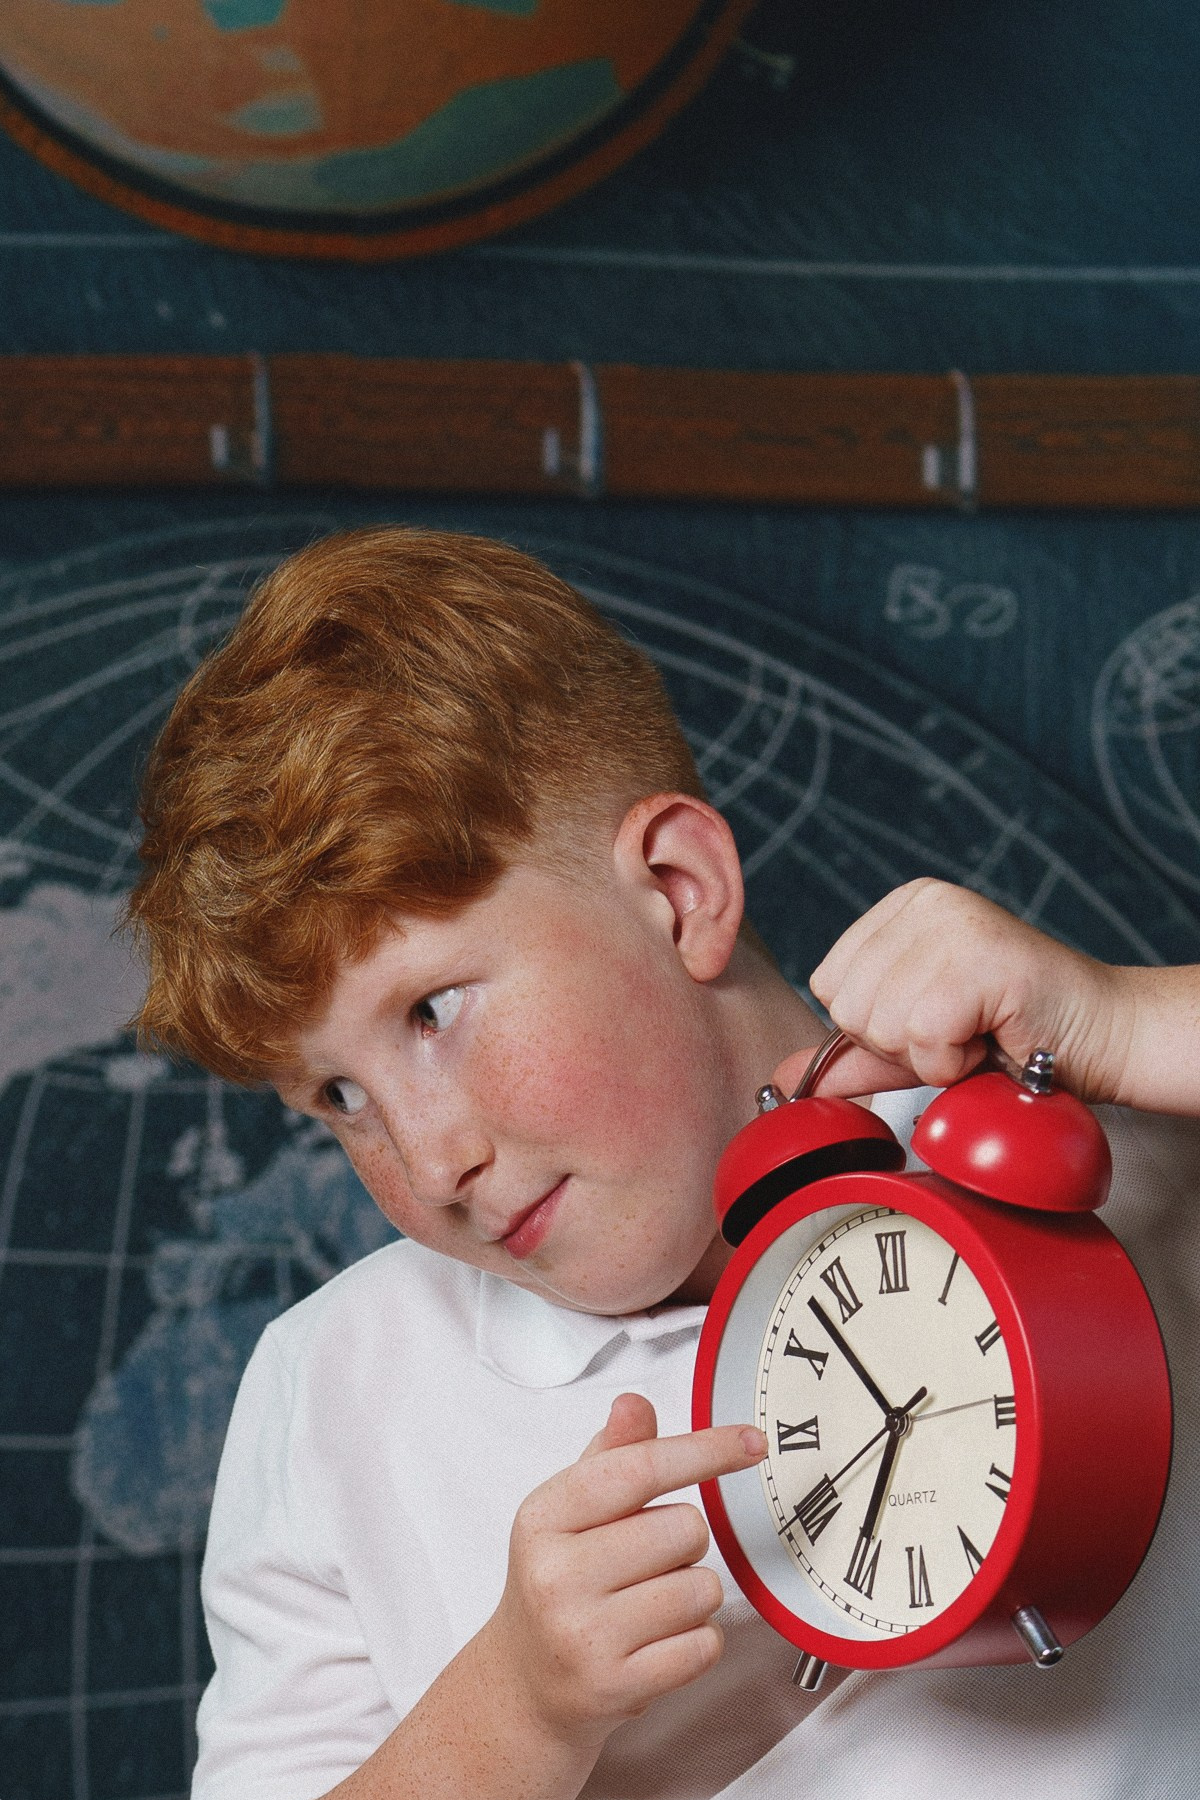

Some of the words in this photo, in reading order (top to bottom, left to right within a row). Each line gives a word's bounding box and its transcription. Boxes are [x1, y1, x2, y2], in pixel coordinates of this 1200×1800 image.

[819, 1255, 864, 1325] XI
[874, 1229, 910, 1295] XII
[783, 1327, 830, 1381] X
[776, 1414, 821, 1456] IX
[792, 1472, 843, 1547] VIII
[888, 1490, 937, 1507] QUARTZ
[842, 1525, 883, 1601] VII
[904, 1544, 935, 1609] VI
